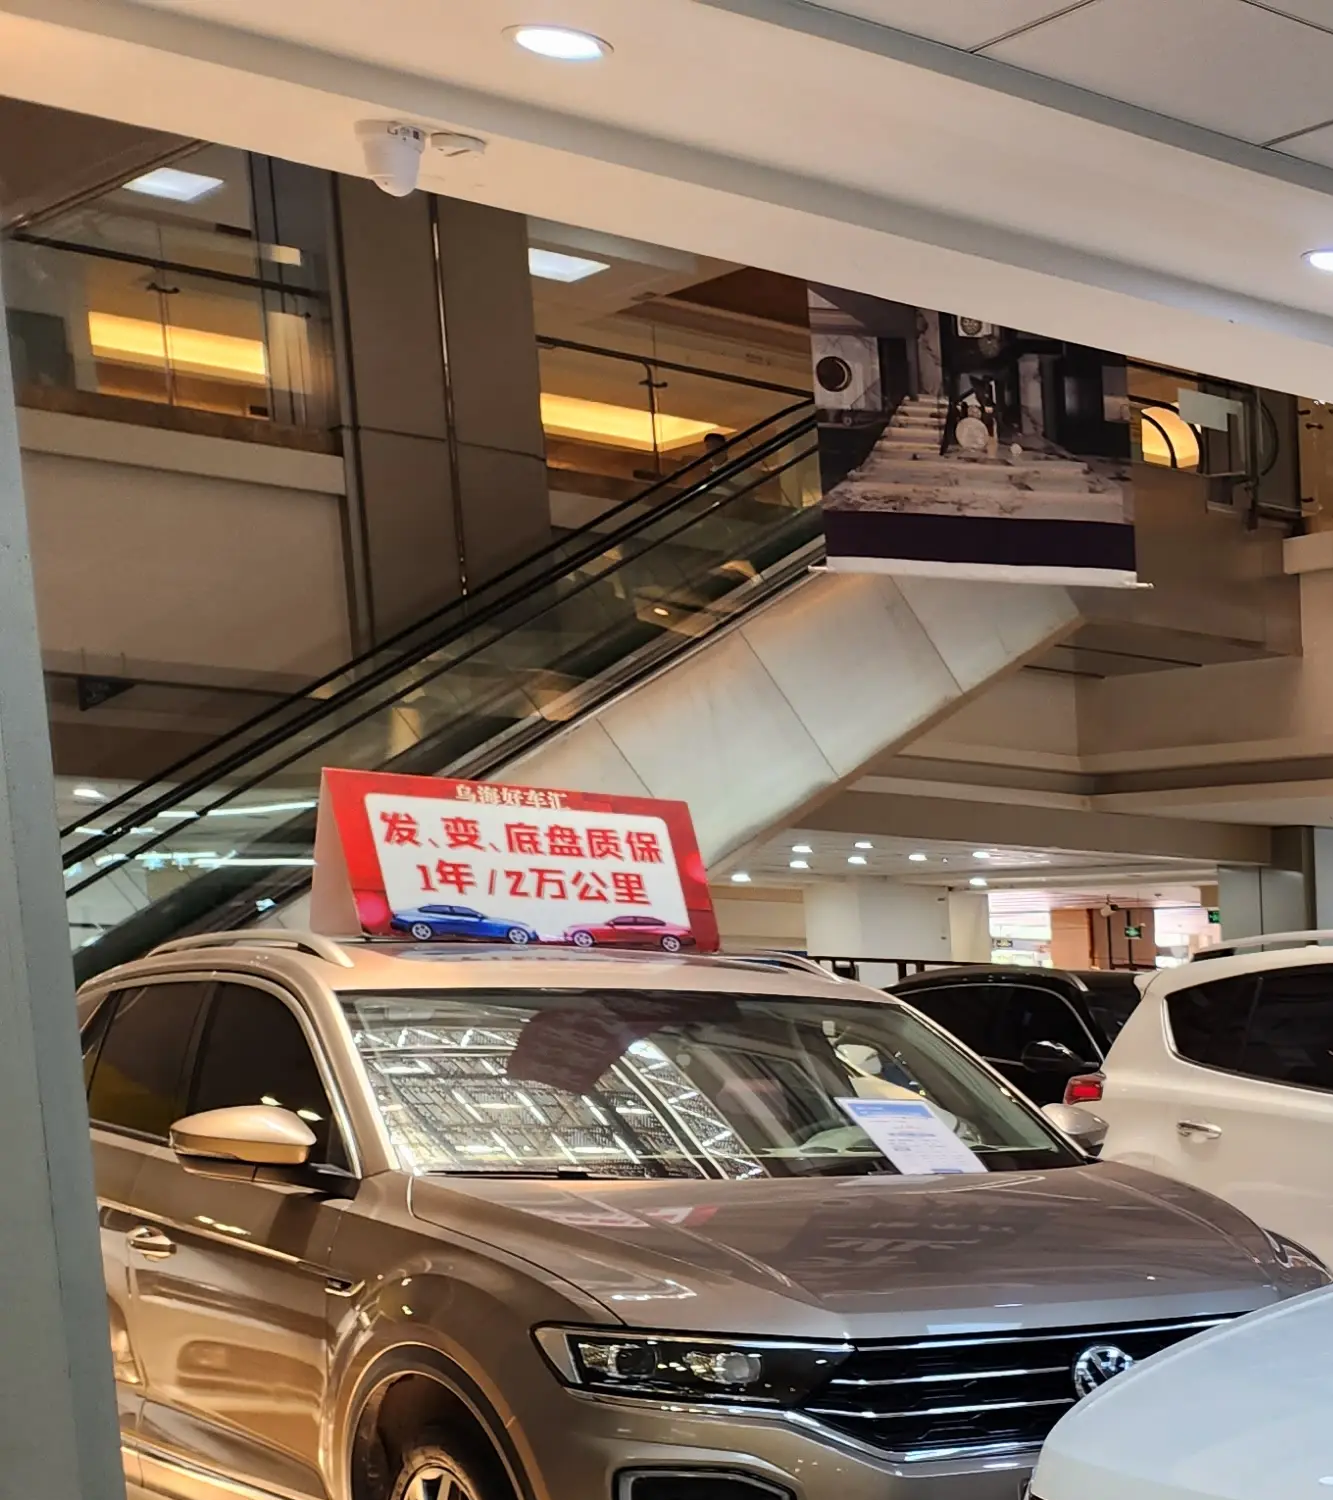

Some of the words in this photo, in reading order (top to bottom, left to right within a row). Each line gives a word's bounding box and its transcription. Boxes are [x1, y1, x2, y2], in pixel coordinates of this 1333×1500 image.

[456, 784, 571, 810] 乌海好车汇
[380, 811, 664, 863] 发、变、底盘质保
